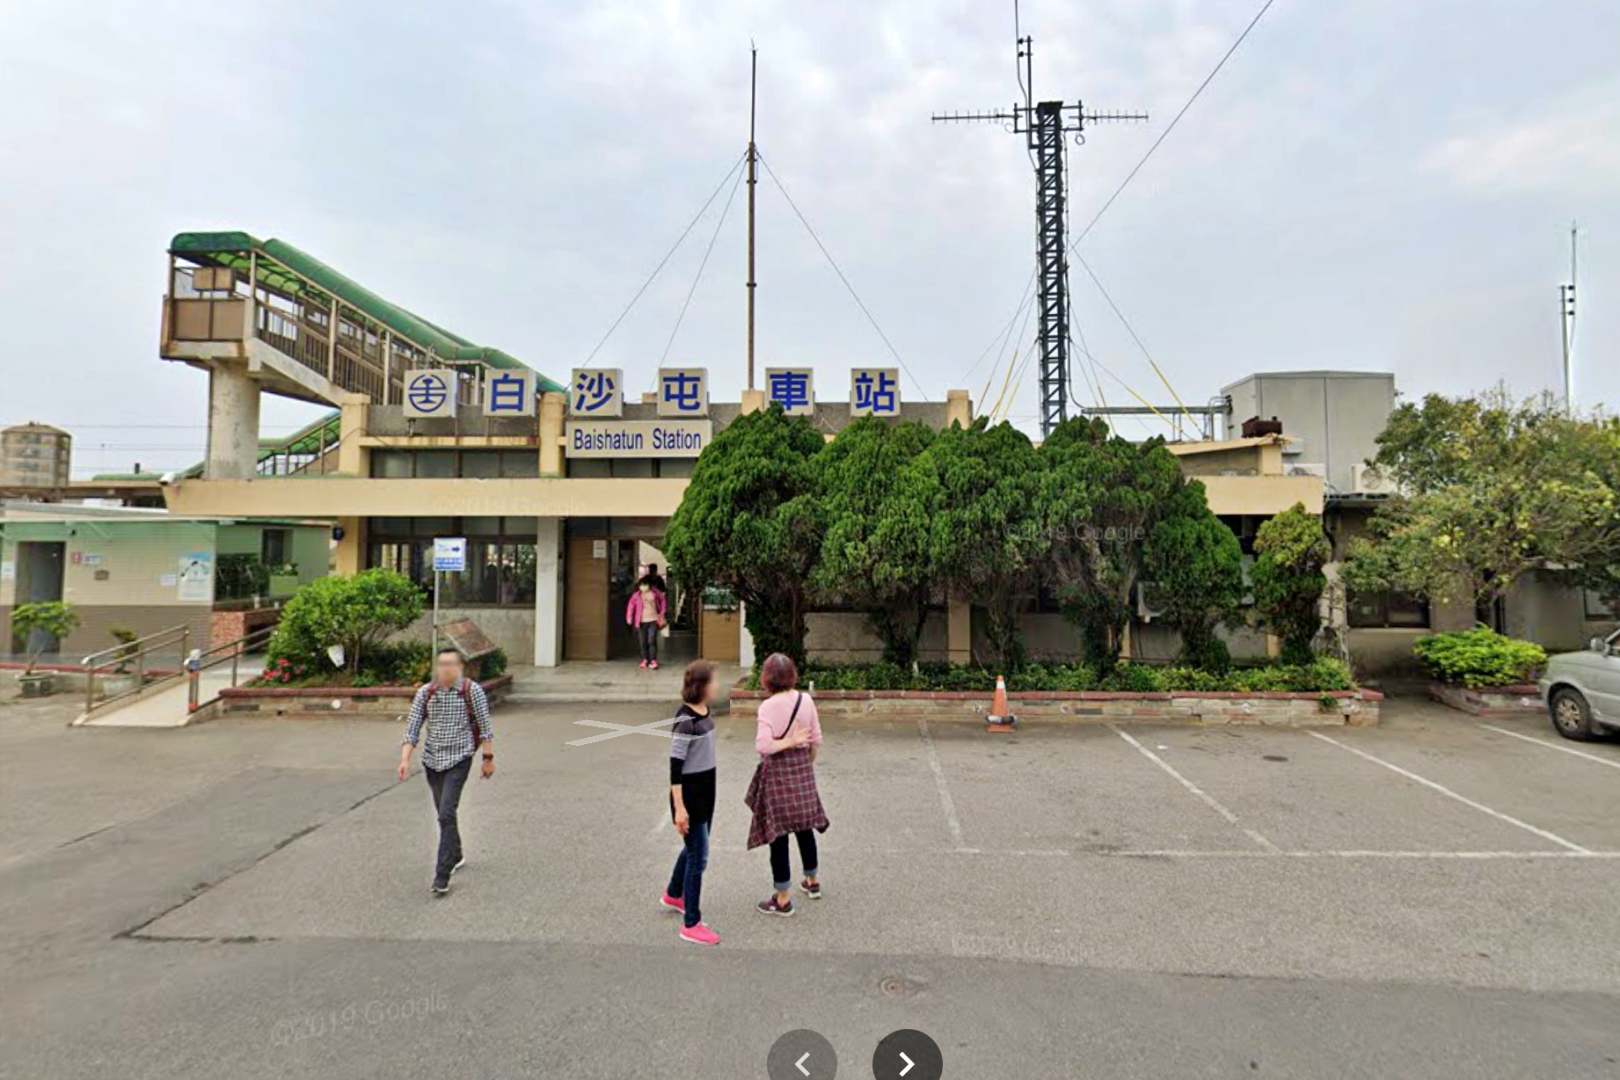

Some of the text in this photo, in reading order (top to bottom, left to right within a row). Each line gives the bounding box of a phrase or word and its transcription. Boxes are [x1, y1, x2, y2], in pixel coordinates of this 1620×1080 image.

[491, 372, 895, 411] 白沙屯車站
[574, 426, 701, 450] Baishatun Station
